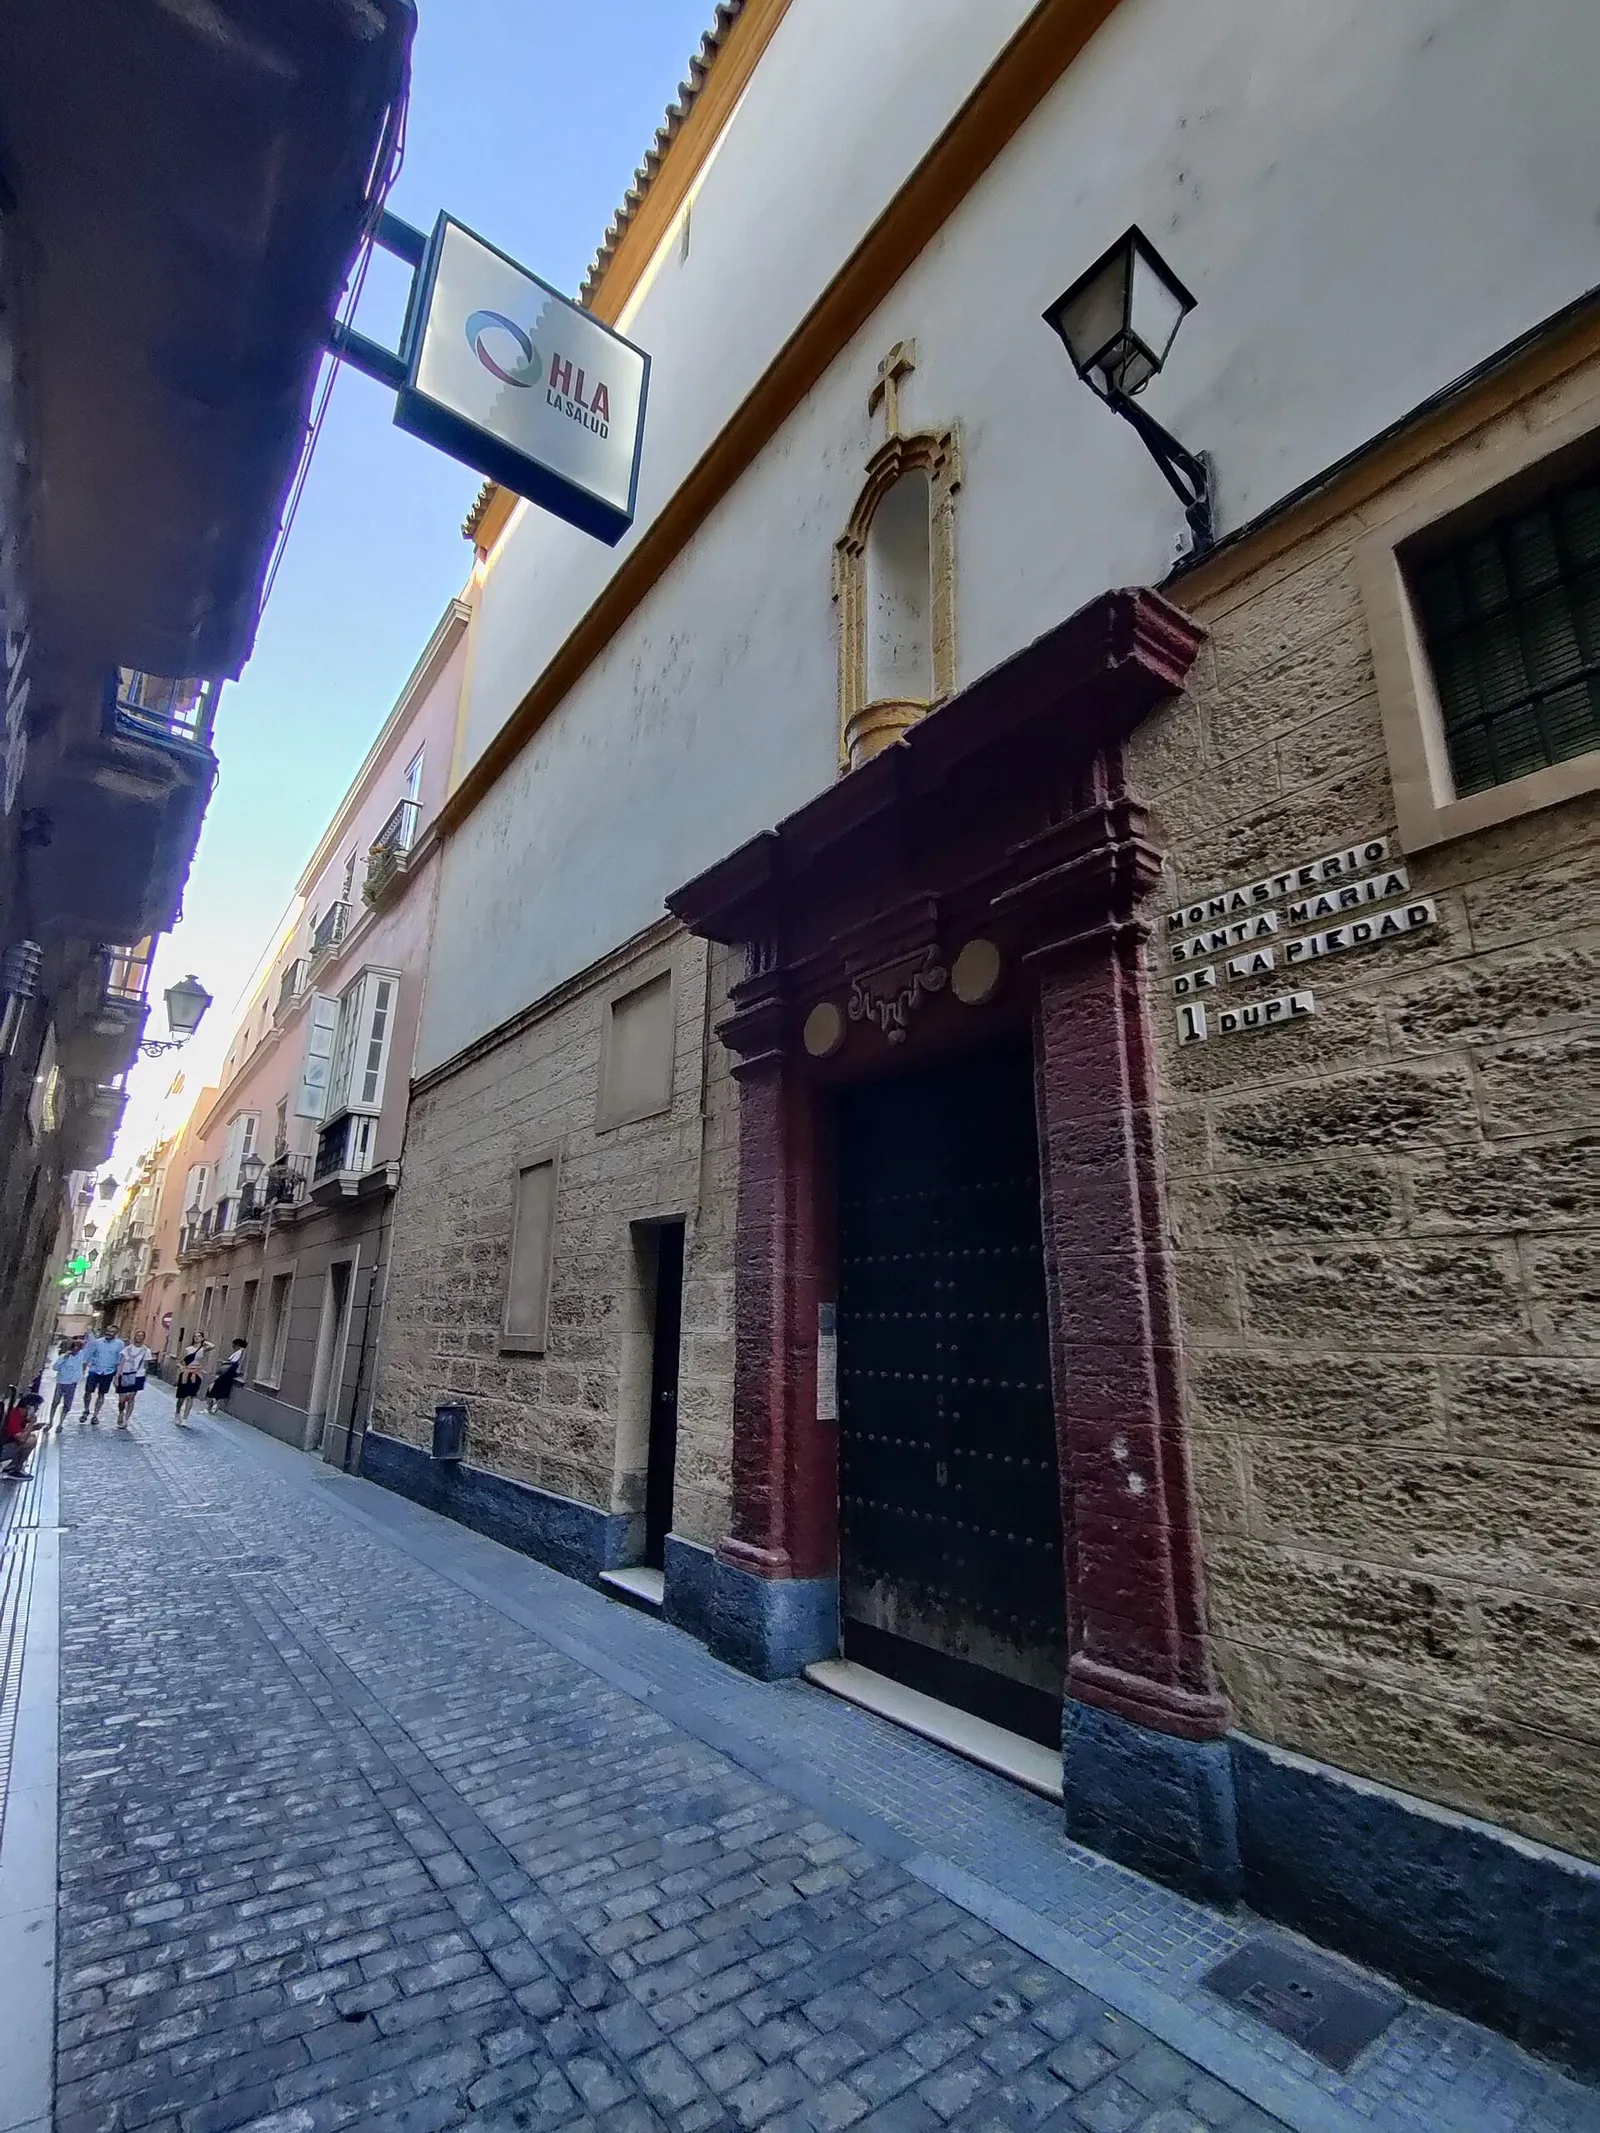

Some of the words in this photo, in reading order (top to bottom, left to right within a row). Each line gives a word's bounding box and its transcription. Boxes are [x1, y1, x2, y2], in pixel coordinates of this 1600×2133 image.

[546, 389, 562, 412] LA
[566, 401, 608, 439] SALUD
[550, 353, 609, 422] HLA
[1169, 842, 1384, 932] MONASTERIO
[1173, 917, 1272, 961] SANTA
[1290, 874, 1404, 924] MARIA
[1175, 969, 1209, 994] DE
[1229, 953, 1268, 976] LA
[1286, 905, 1429, 962] PIEDAD
[1182, 1007, 1200, 1041] 1
[1221, 997, 1308, 1032] DUPL
